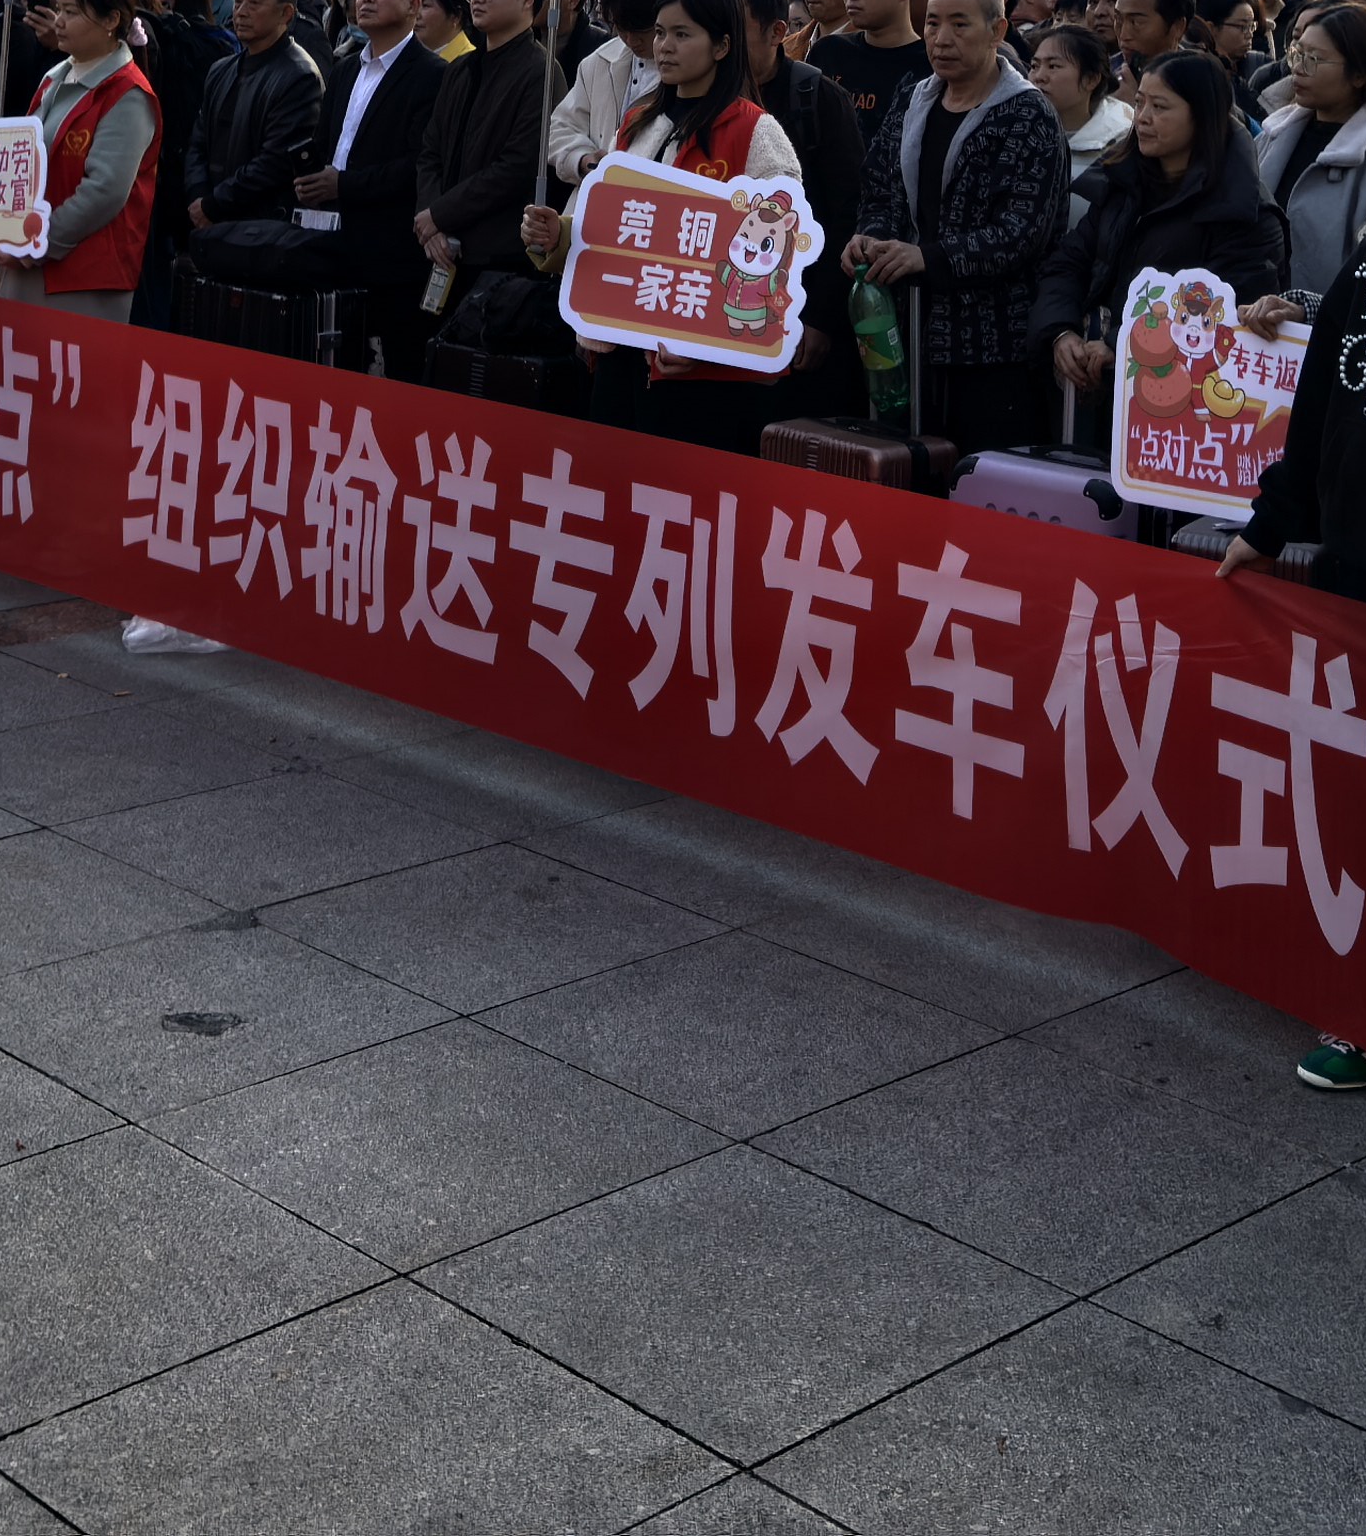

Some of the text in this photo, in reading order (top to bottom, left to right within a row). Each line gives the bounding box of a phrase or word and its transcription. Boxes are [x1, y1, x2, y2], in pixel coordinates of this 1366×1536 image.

[617, 199, 717, 259] 莞 铜
[601, 264, 713, 320] 一家亲
